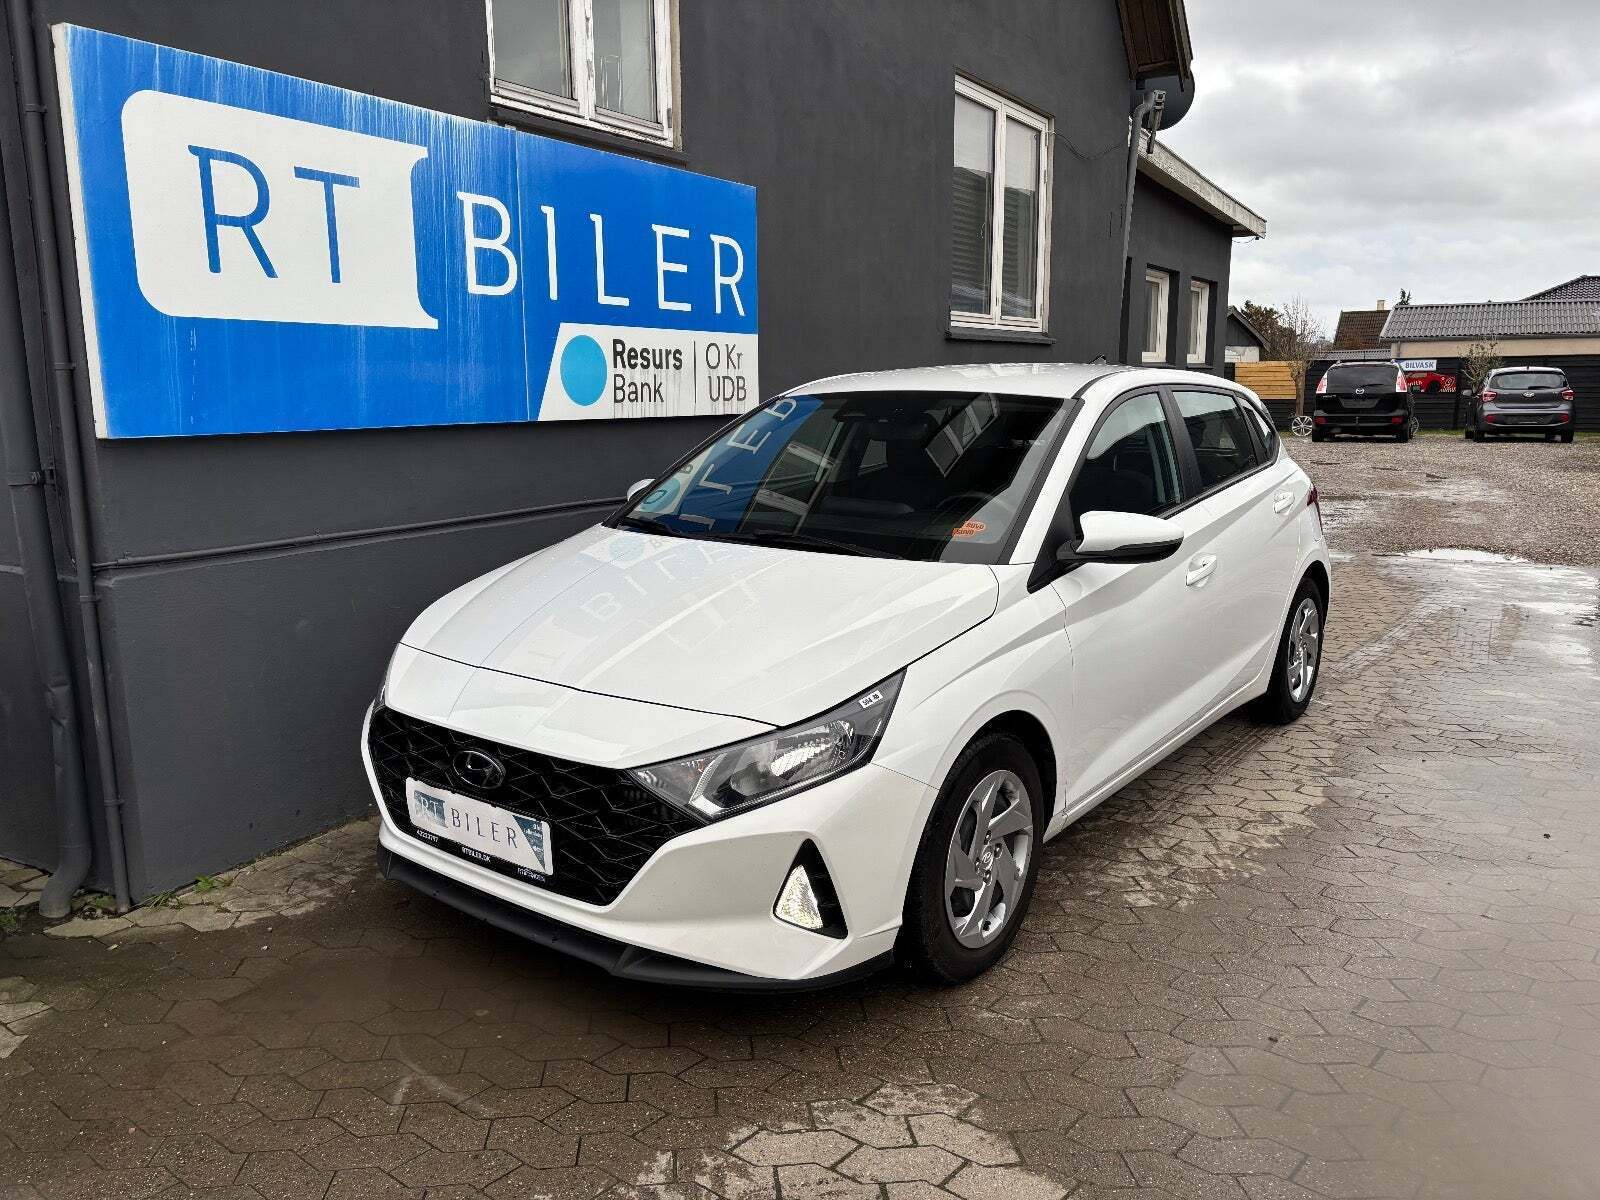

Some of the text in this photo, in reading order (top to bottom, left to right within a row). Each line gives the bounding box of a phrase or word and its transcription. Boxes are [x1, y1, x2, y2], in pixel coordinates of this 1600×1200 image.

[187, 144, 746, 317] RT BILER
[612, 338, 683, 370] Resurs
[726, 343, 744, 370] Kr
[1405, 361, 1434, 369] BILVASK
[613, 373, 665, 403] Bank
[707, 375, 747, 402] UDB
[420, 796, 518, 848] RT BILER
